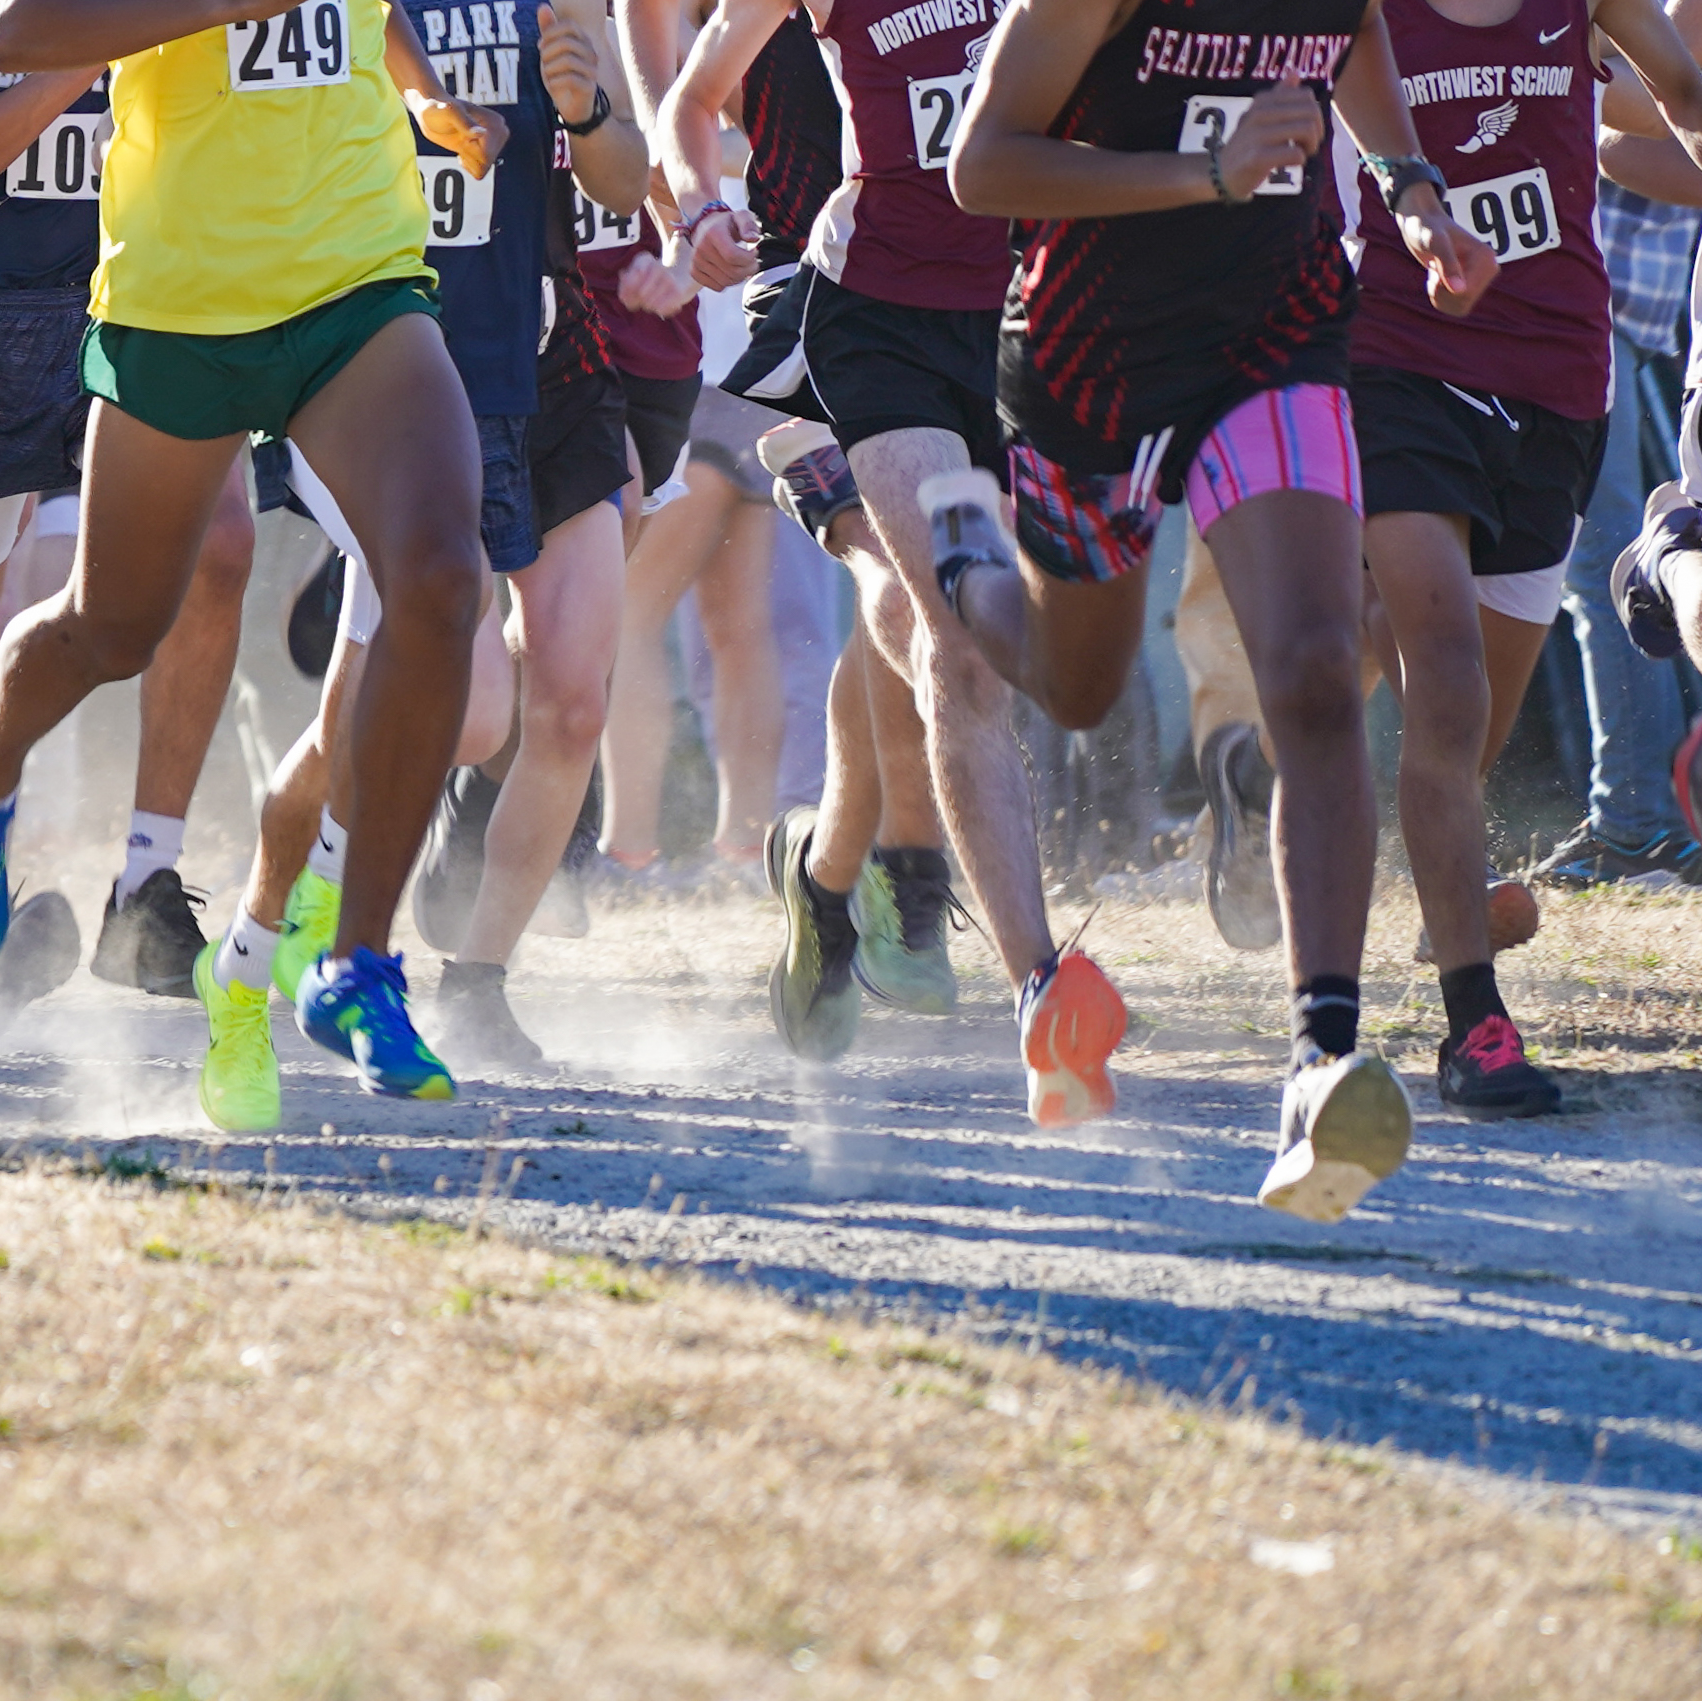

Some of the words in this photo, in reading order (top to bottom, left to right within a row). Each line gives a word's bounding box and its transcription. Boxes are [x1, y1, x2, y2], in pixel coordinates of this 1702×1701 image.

[235, 2, 343, 82] 249
[423, 0, 520, 51] PARK
[1137, 26, 1252, 83] SEATTLE
[1400, 66, 1506, 107] ORTHWEST
[17, 124, 101, 194] 10
[1443, 181, 1549, 257] 99
